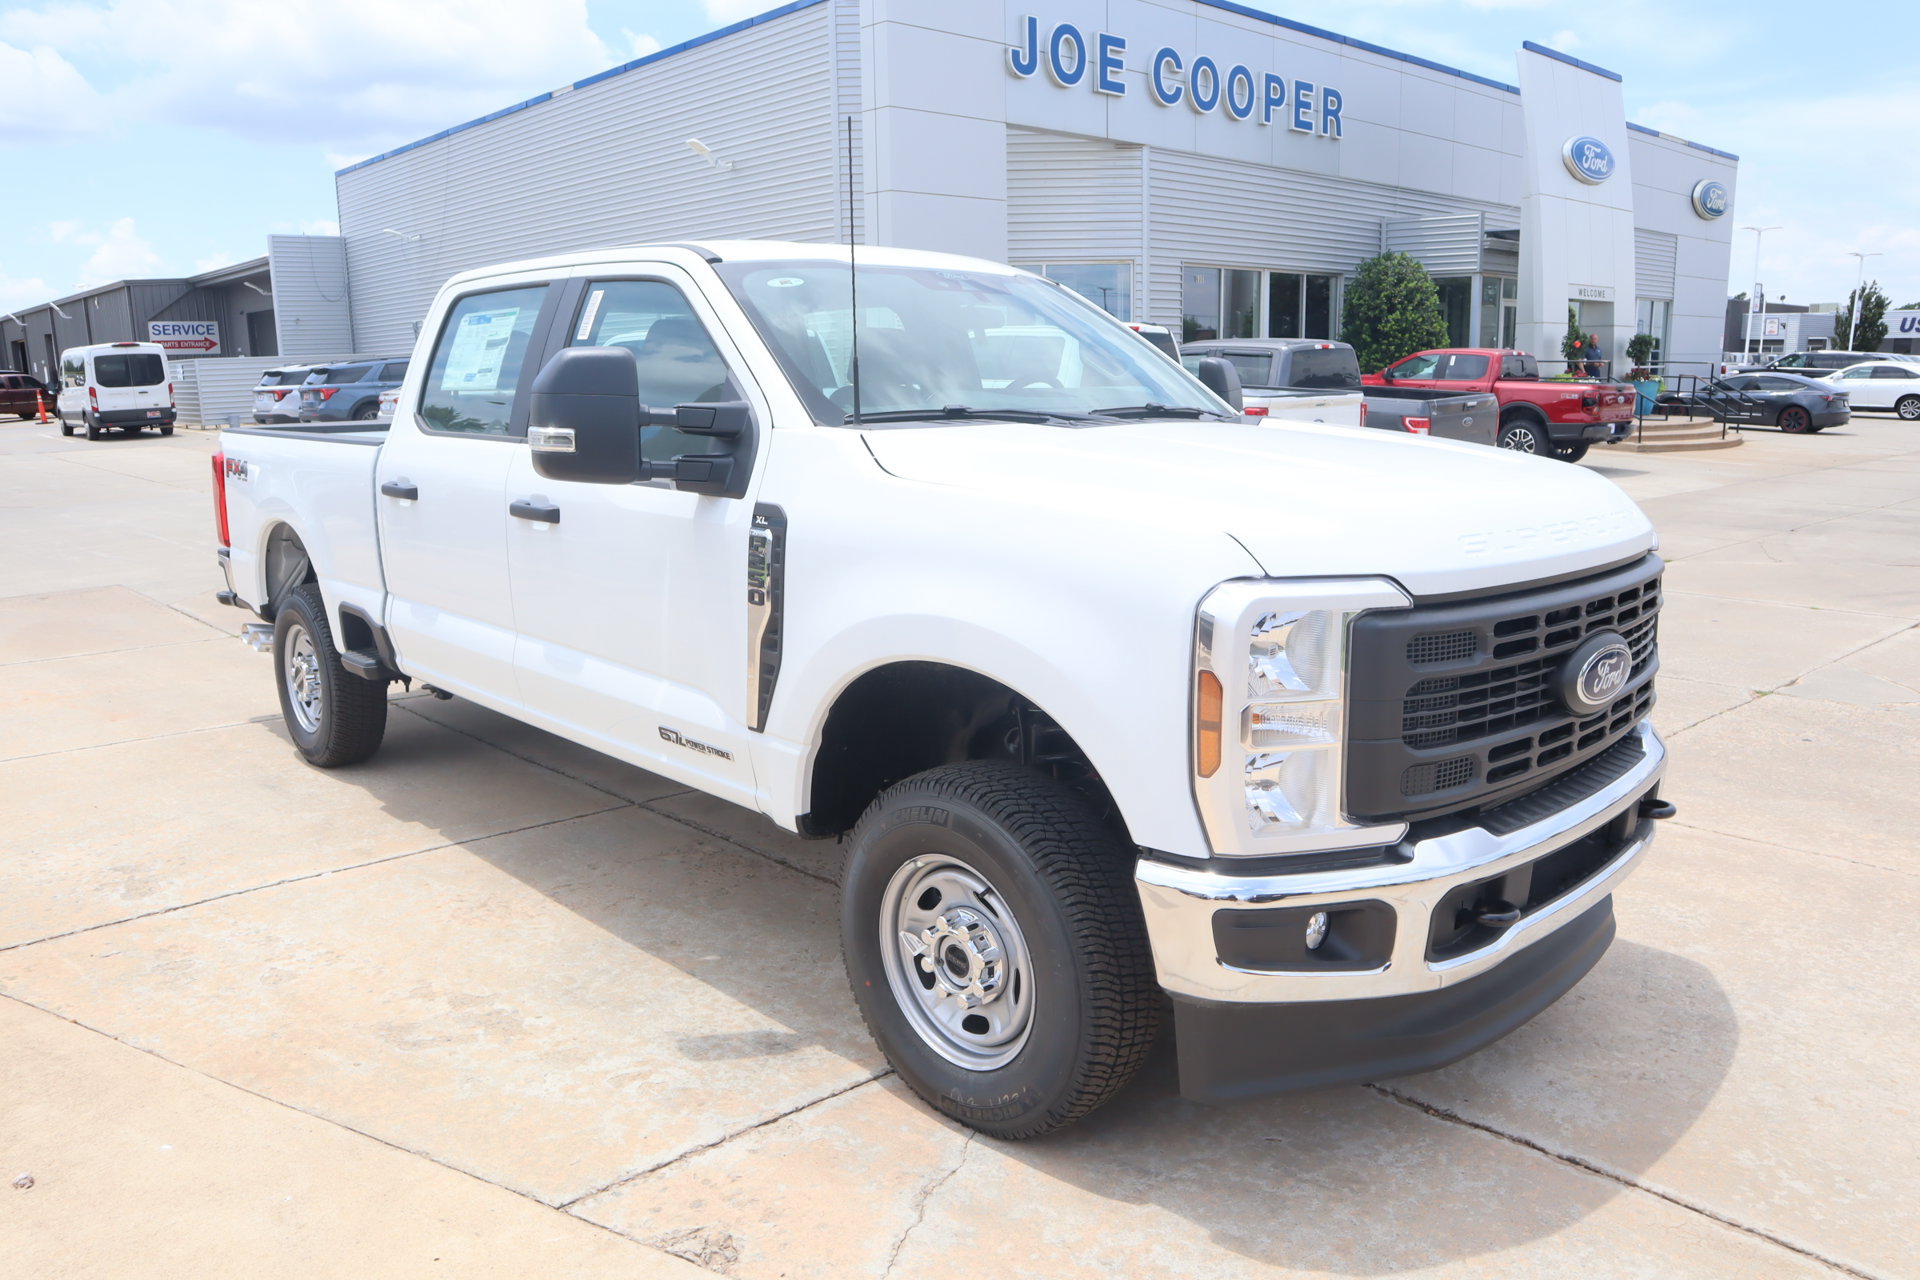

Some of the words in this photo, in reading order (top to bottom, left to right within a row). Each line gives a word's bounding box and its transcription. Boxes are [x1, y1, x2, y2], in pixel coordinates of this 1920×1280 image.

[1006, 14, 1127, 97] JOE
[1149, 45, 1344, 140] COOPER
[1581, 143, 1609, 173] Ford
[1706, 187, 1727, 211] Ford
[1578, 288, 1606, 299] WELCOME
[151, 324, 216, 336] SERVICE
[180, 340, 210, 348] ENTRANCE
[226, 457, 248, 478] FX4
[755, 515, 768, 525] XL
[1593, 656, 1624, 694] Ford
[685, 738, 706, 753] POWER
[706, 745, 731, 761] STROKE
